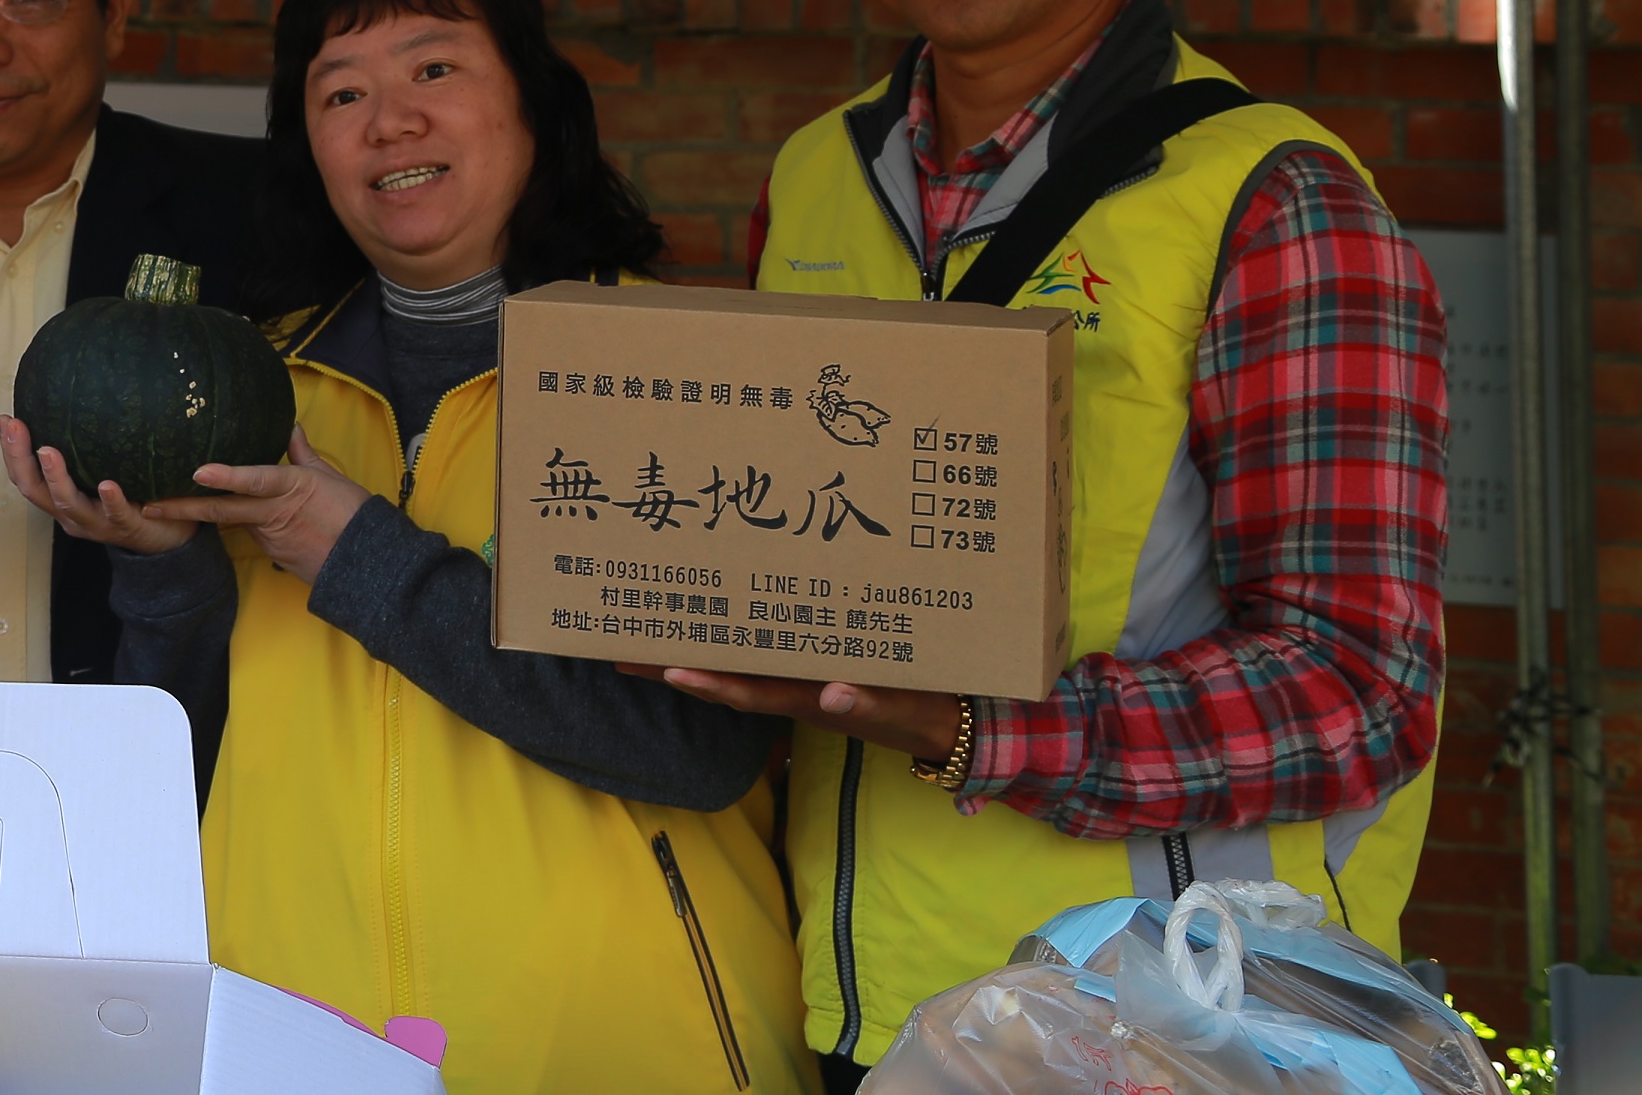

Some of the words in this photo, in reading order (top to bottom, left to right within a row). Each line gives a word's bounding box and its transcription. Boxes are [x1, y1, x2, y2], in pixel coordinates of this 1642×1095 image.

[538, 371, 793, 410] 國家級檢驗證明無毒
[943, 432, 998, 455] 57號
[942, 464, 997, 487] 66號
[529, 447, 892, 542] 無毒地瓜
[941, 498, 996, 520] 72號
[940, 530, 996, 553] 73號
[600, 586, 730, 618] 村里幹事農園
[750, 573, 799, 595] LINE
[860, 583, 974, 610] jau861203
